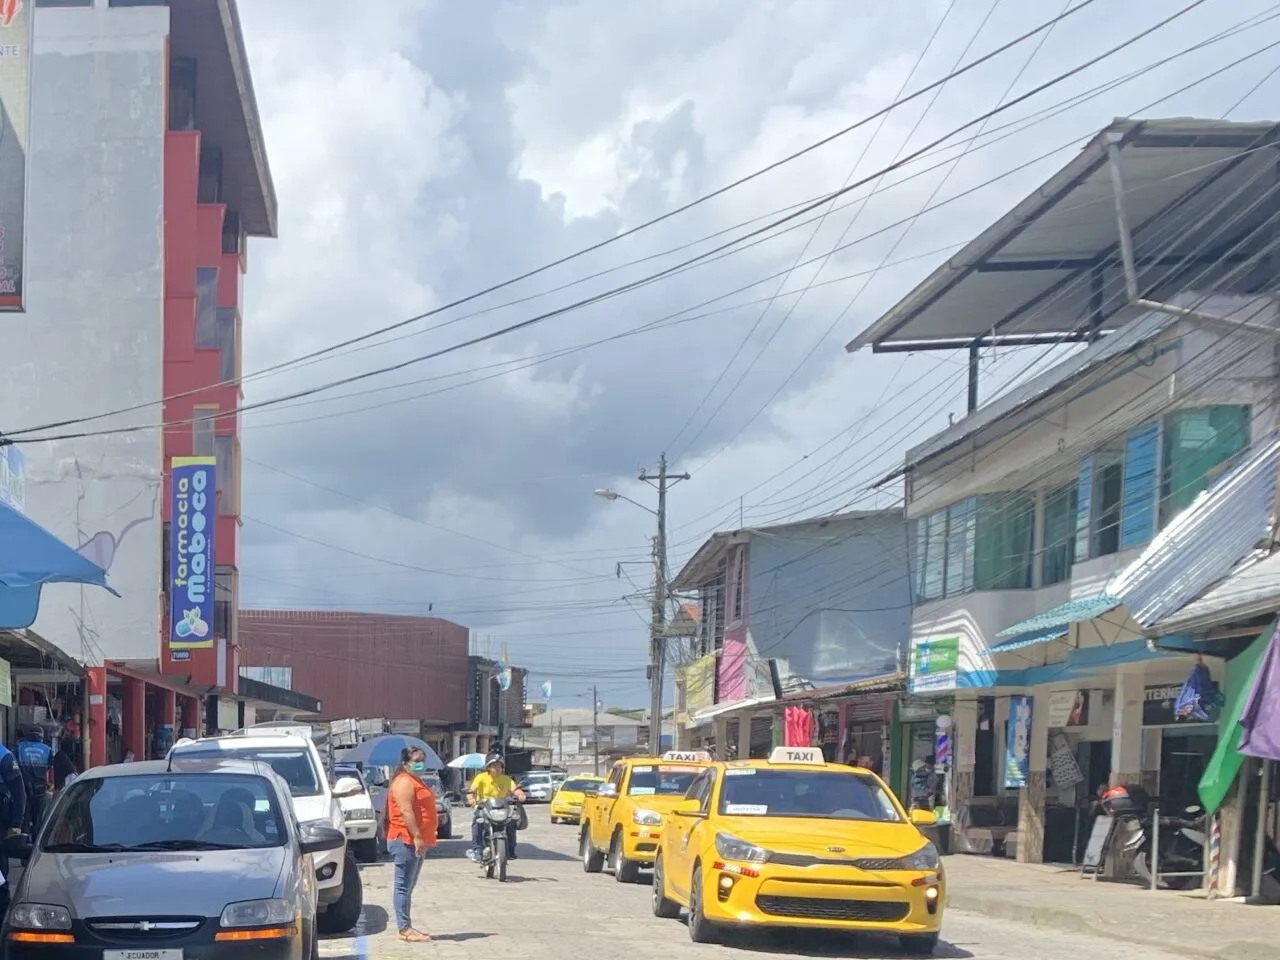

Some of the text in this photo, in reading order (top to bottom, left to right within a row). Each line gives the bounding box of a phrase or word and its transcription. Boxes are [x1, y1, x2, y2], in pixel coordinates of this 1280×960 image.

[175, 477, 189, 587] farmacia
[669, 753, 696, 761] TAXI
[787, 751, 814, 762] TAXI
[126, 951, 160, 960] ECUADOR
